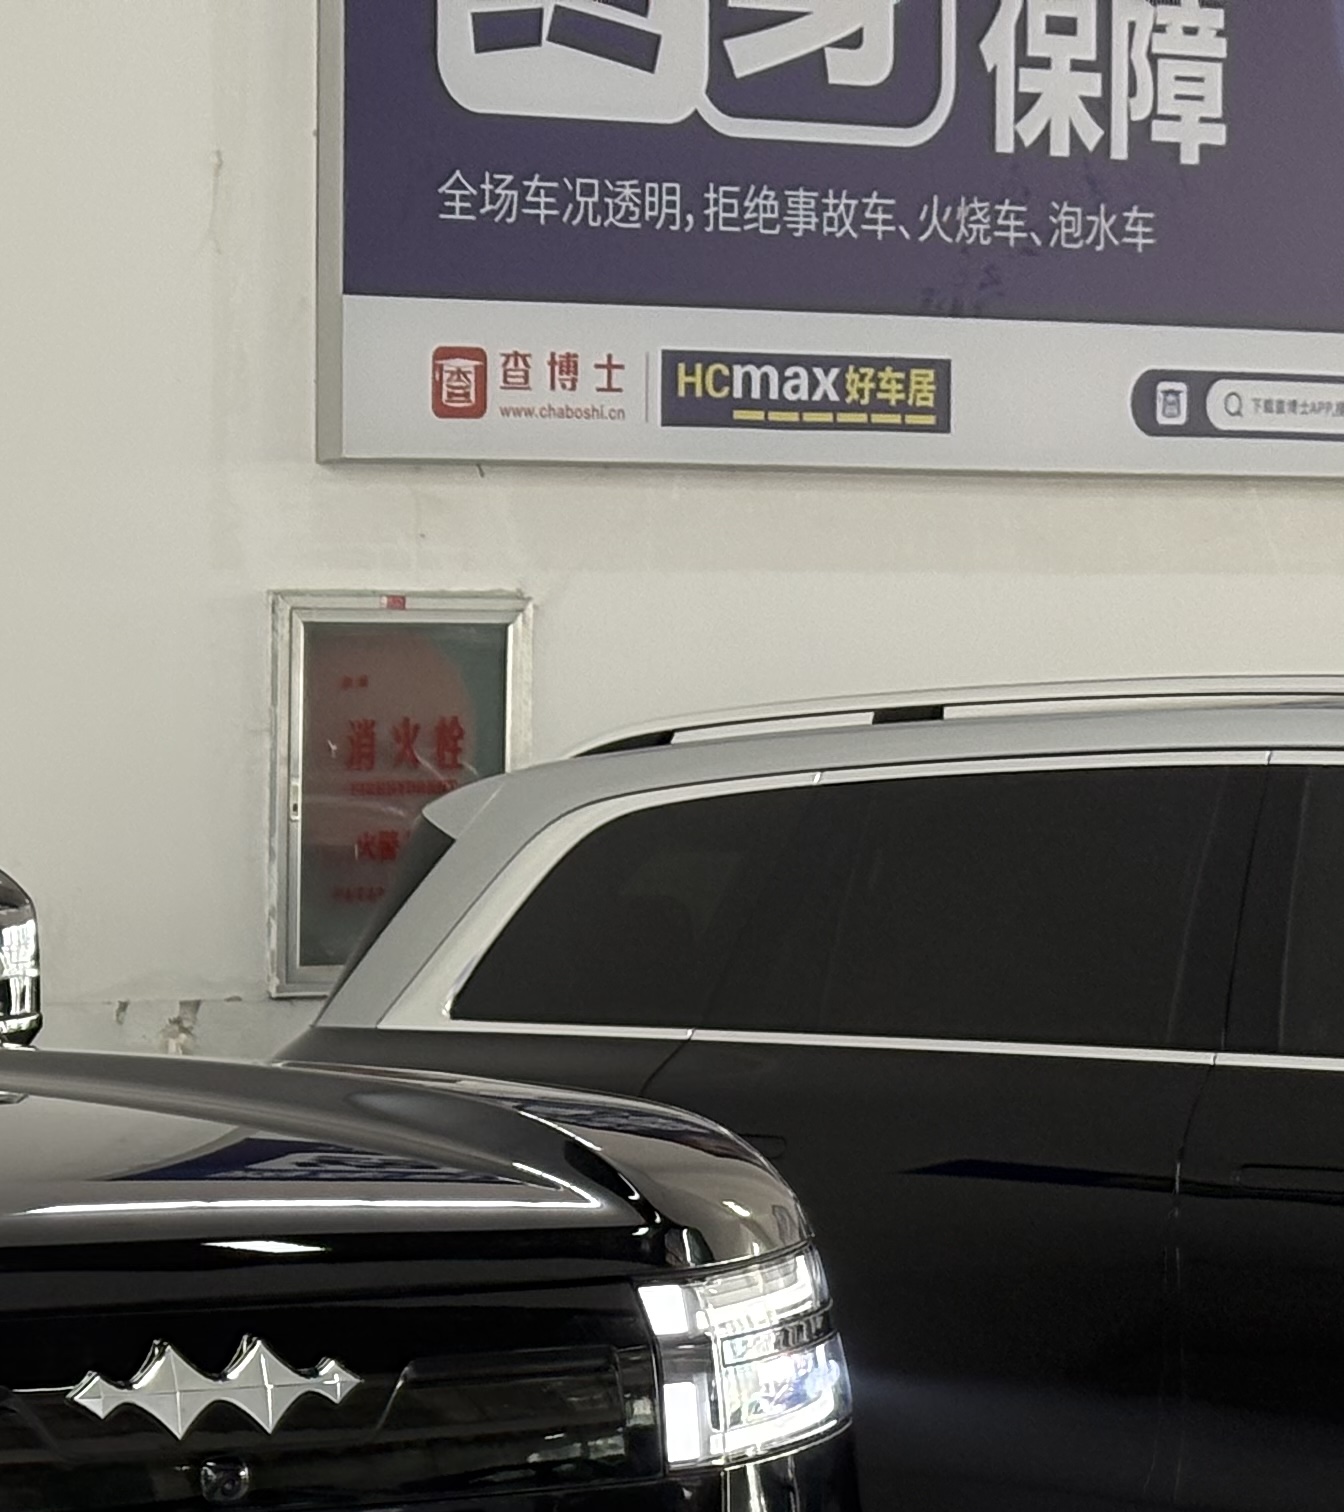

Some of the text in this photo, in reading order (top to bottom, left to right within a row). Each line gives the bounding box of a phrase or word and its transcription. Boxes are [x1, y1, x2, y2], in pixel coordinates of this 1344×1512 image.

[499, 350, 625, 393] 查博士
[499, 404, 625, 421] www.chaboshi.cn
